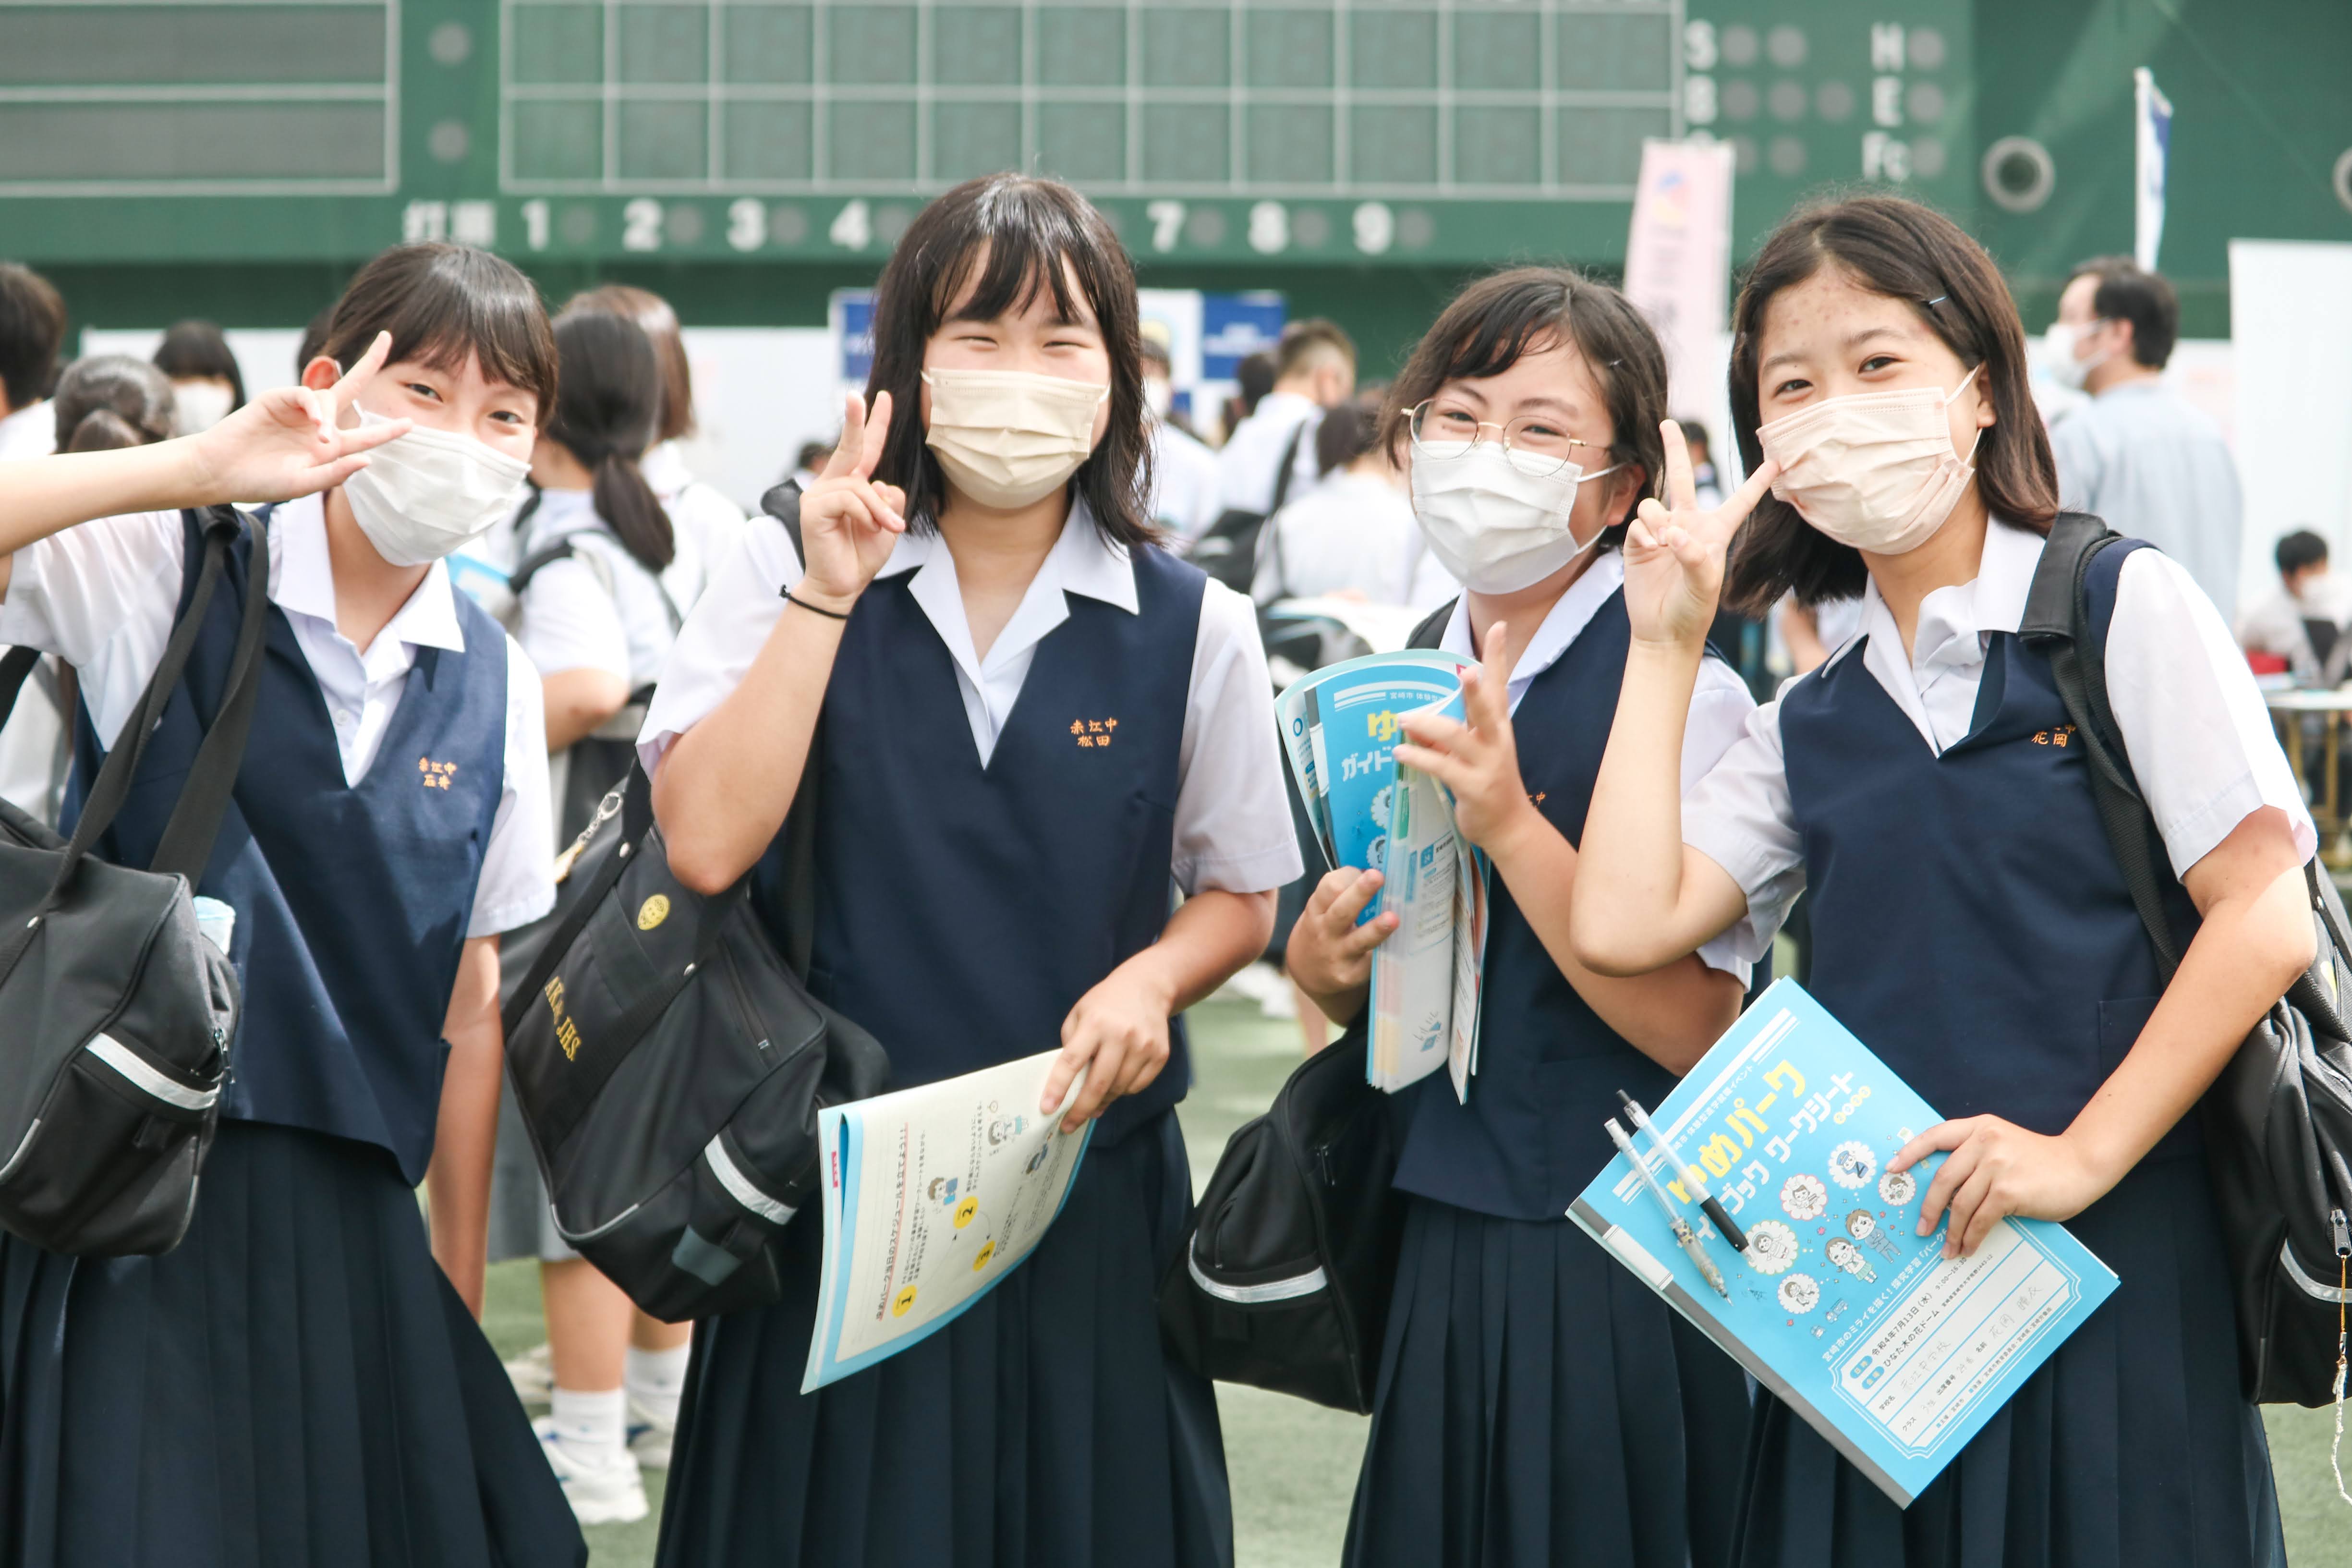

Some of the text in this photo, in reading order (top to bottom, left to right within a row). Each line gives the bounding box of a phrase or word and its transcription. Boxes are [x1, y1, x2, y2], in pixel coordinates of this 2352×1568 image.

[1685, 20, 1718, 70] S
[1871, 23, 1905, 72] H
[1684, 74, 1718, 124] B
[1872, 76, 1903, 126] E
[521, 200, 549, 250] 1
[623, 198, 663, 251] 2
[727, 198, 767, 251] 3
[829, 199, 872, 251] 4
[1146, 201, 1185, 253] 7
[1248, 200, 1289, 255] 8
[1352, 202, 1394, 255] 9
[1390, 692, 1440, 701] 宮崎市 体験型
[1070, 717, 1118, 735] 赤江中
[2053, 724, 2076, 734] 中
[1078, 735, 1111, 748] 松田
[2031, 730, 2069, 748] 花岡
[1763, 1071, 1854, 1164] ワークシート
[961, 1204, 973, 1219] 2
[979, 1247, 990, 1262] 3
[900, 1293, 912, 1307] 1
[1870, 1291, 1933, 1358] 令和4年7月13日（水）
[1882, 1307, 1940, 1368] ひなた木の花ドーム
[1975, 1340, 1988, 1354] 名前
[1934, 1373, 1957, 1396] 出席番号
[1878, 1393, 1896, 1412] 学校名
[1901, 1415, 1918, 1433] クラス
